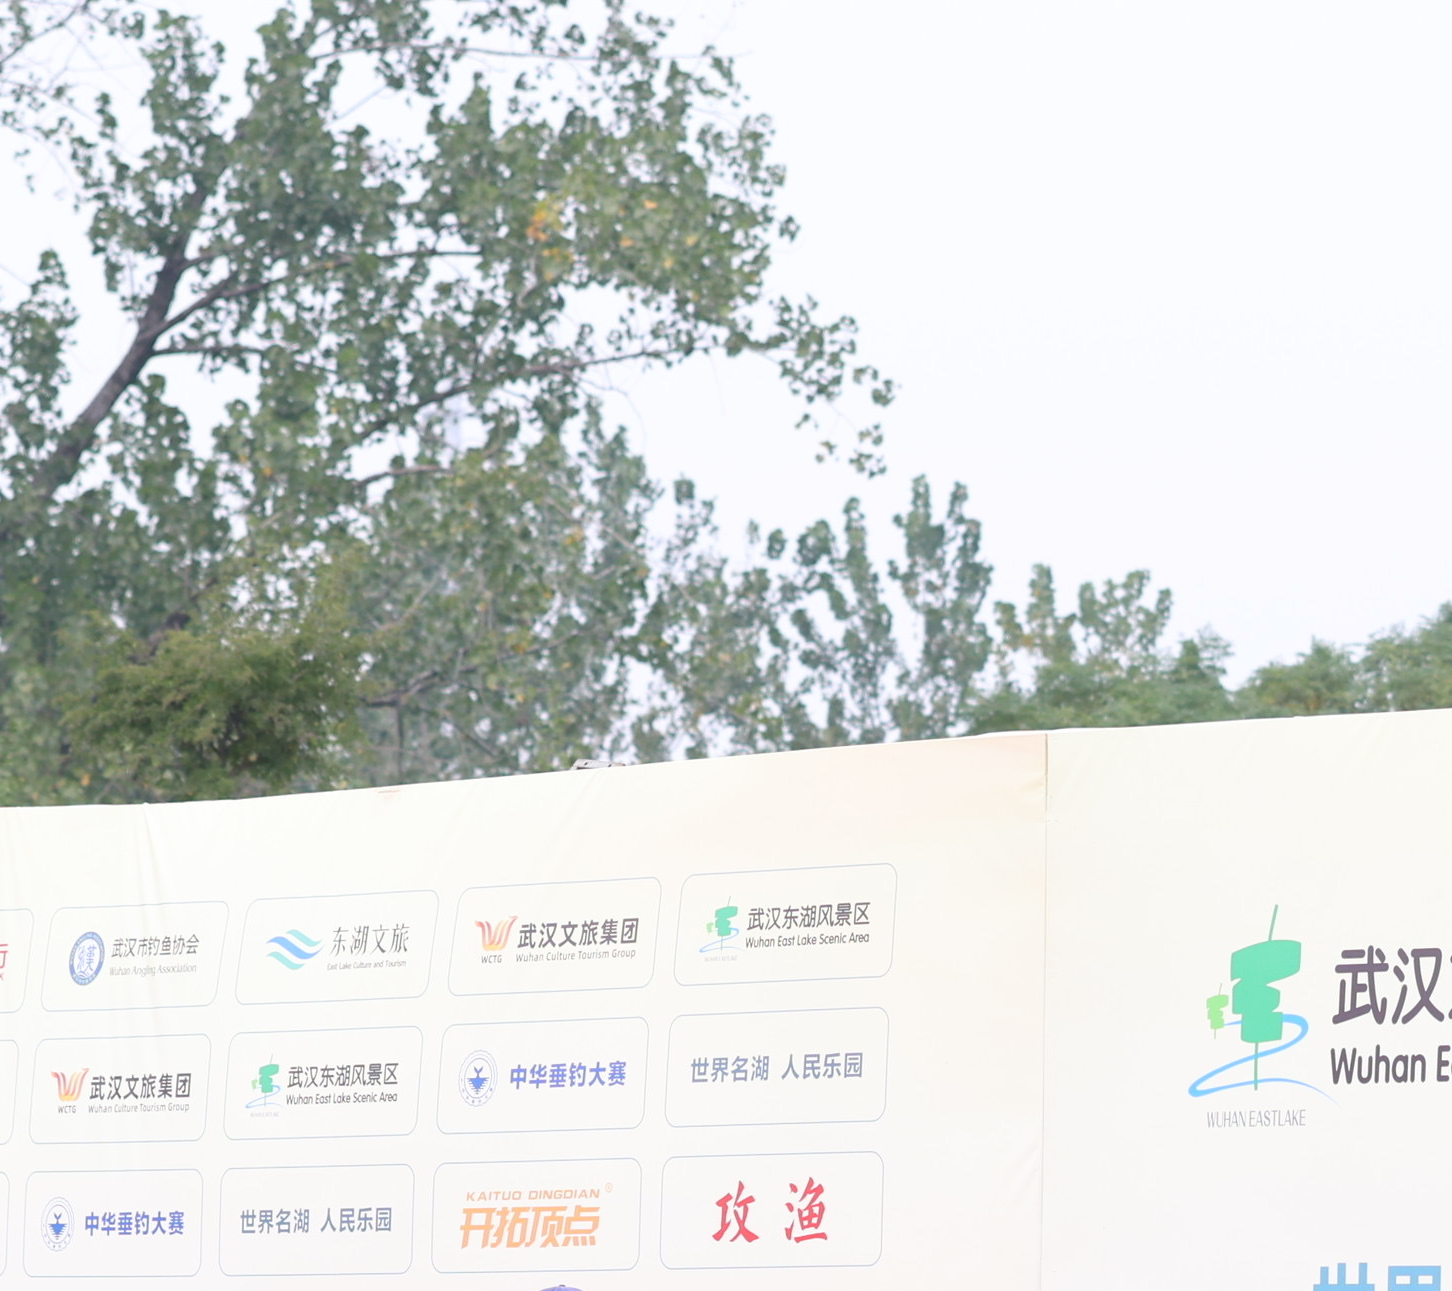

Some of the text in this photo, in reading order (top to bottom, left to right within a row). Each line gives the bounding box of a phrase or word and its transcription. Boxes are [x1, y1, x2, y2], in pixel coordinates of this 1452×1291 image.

[747, 901, 871, 931] 武汉东湖风景区
[111, 934, 199, 957] 武汉市钓鱼协会
[331, 923, 409, 955] 东湖文旅
[515, 918, 639, 950] 武汉文旅集团
[745, 931, 869, 949] Wuhan East Lake Scenic Area
[287, 1063, 398, 1088] 武汉东湖风景区
[510, 1061, 626, 1089] 中华垂钓大赛
[691, 1053, 863, 1082] 世界名湖 人民乐园
[1331, 1045, 1426, 1084] Wuhan
[90, 1073, 191, 1100] 武汉文旅集团
[1207, 1111, 1246, 1128] WUHAN
[467, 1189, 600, 1201] KAITUO DINGDIAN
[85, 1211, 184, 1236] 中华垂钓大赛
[240, 1208, 391, 1234] 世界名湖 人民乐园
[460, 1205, 600, 1249] 开拓顶点
